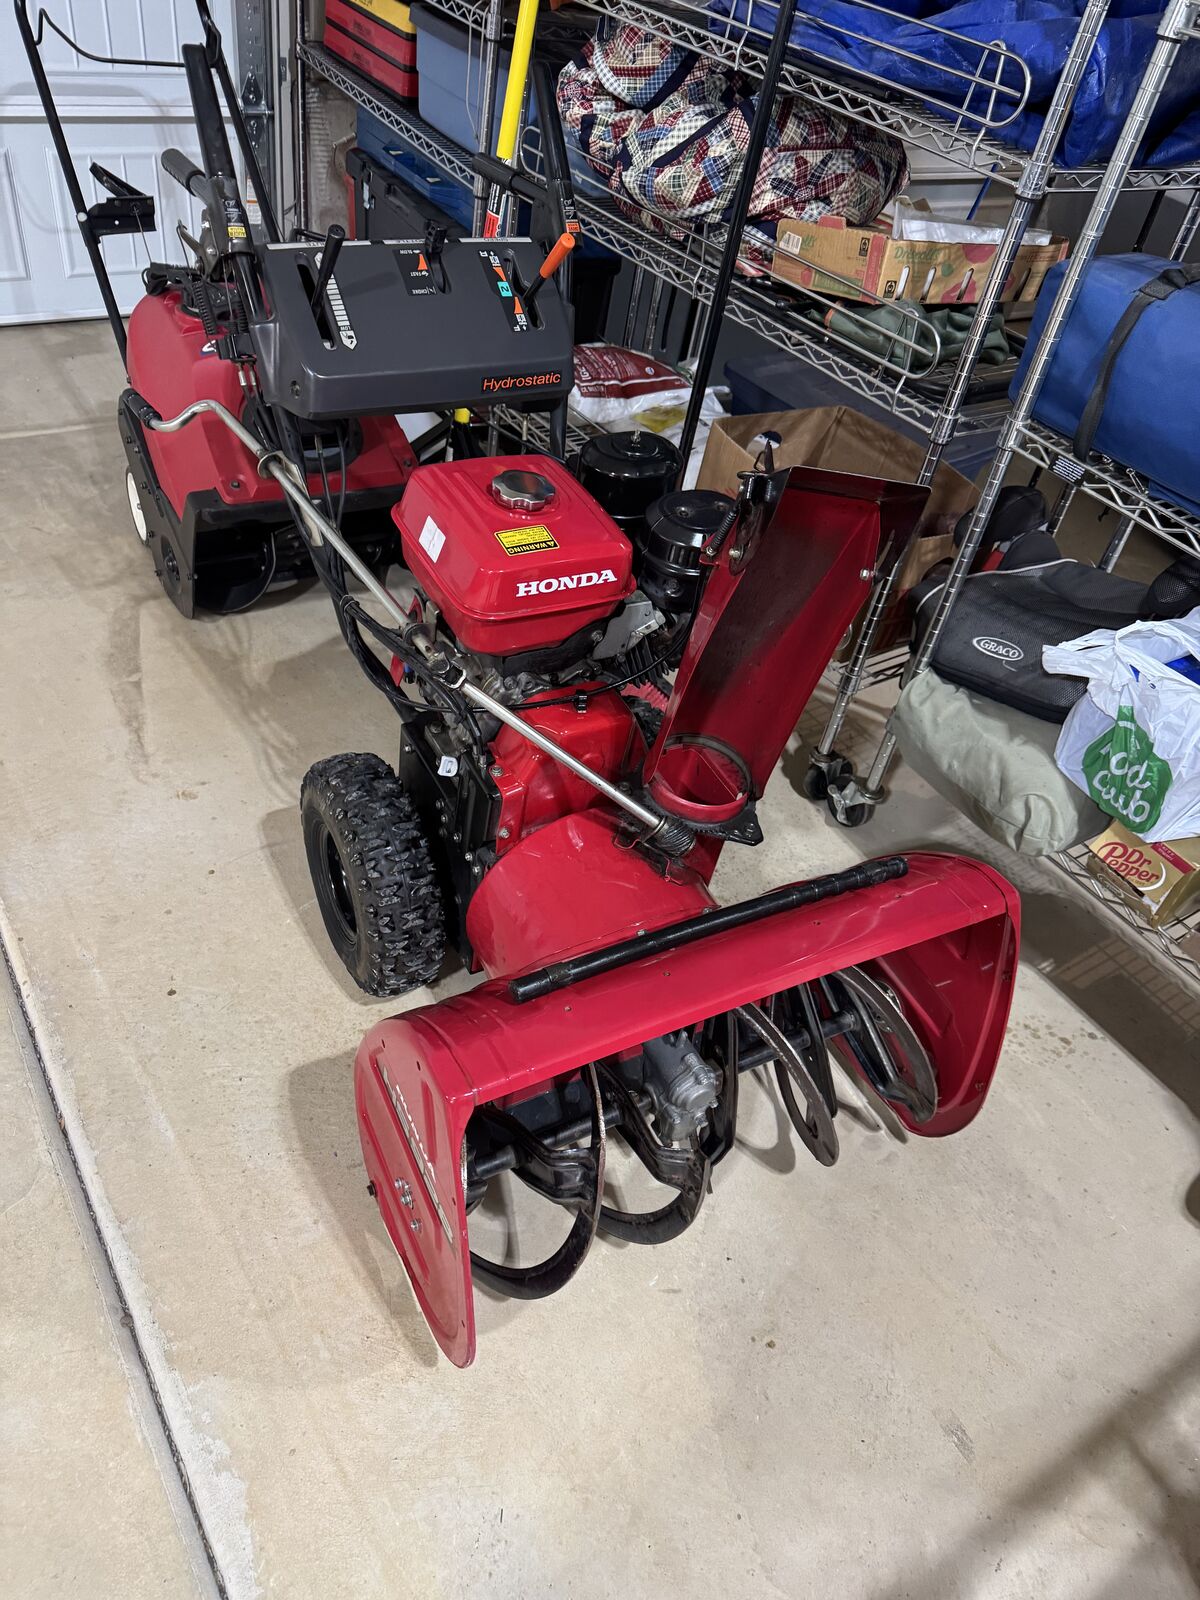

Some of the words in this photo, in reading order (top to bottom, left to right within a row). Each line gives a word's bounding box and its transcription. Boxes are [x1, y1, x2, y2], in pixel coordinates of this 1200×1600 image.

[483, 372, 561, 392] Hydrostatic
[507, 542, 547, 554] WARNING
[515, 569, 618, 597] HONDA
[980, 639, 1019, 658] GRACO
[1092, 770, 1151, 822] Cub
[1097, 841, 1160, 883] Pepper
[1123, 848, 1152, 868] Dr
